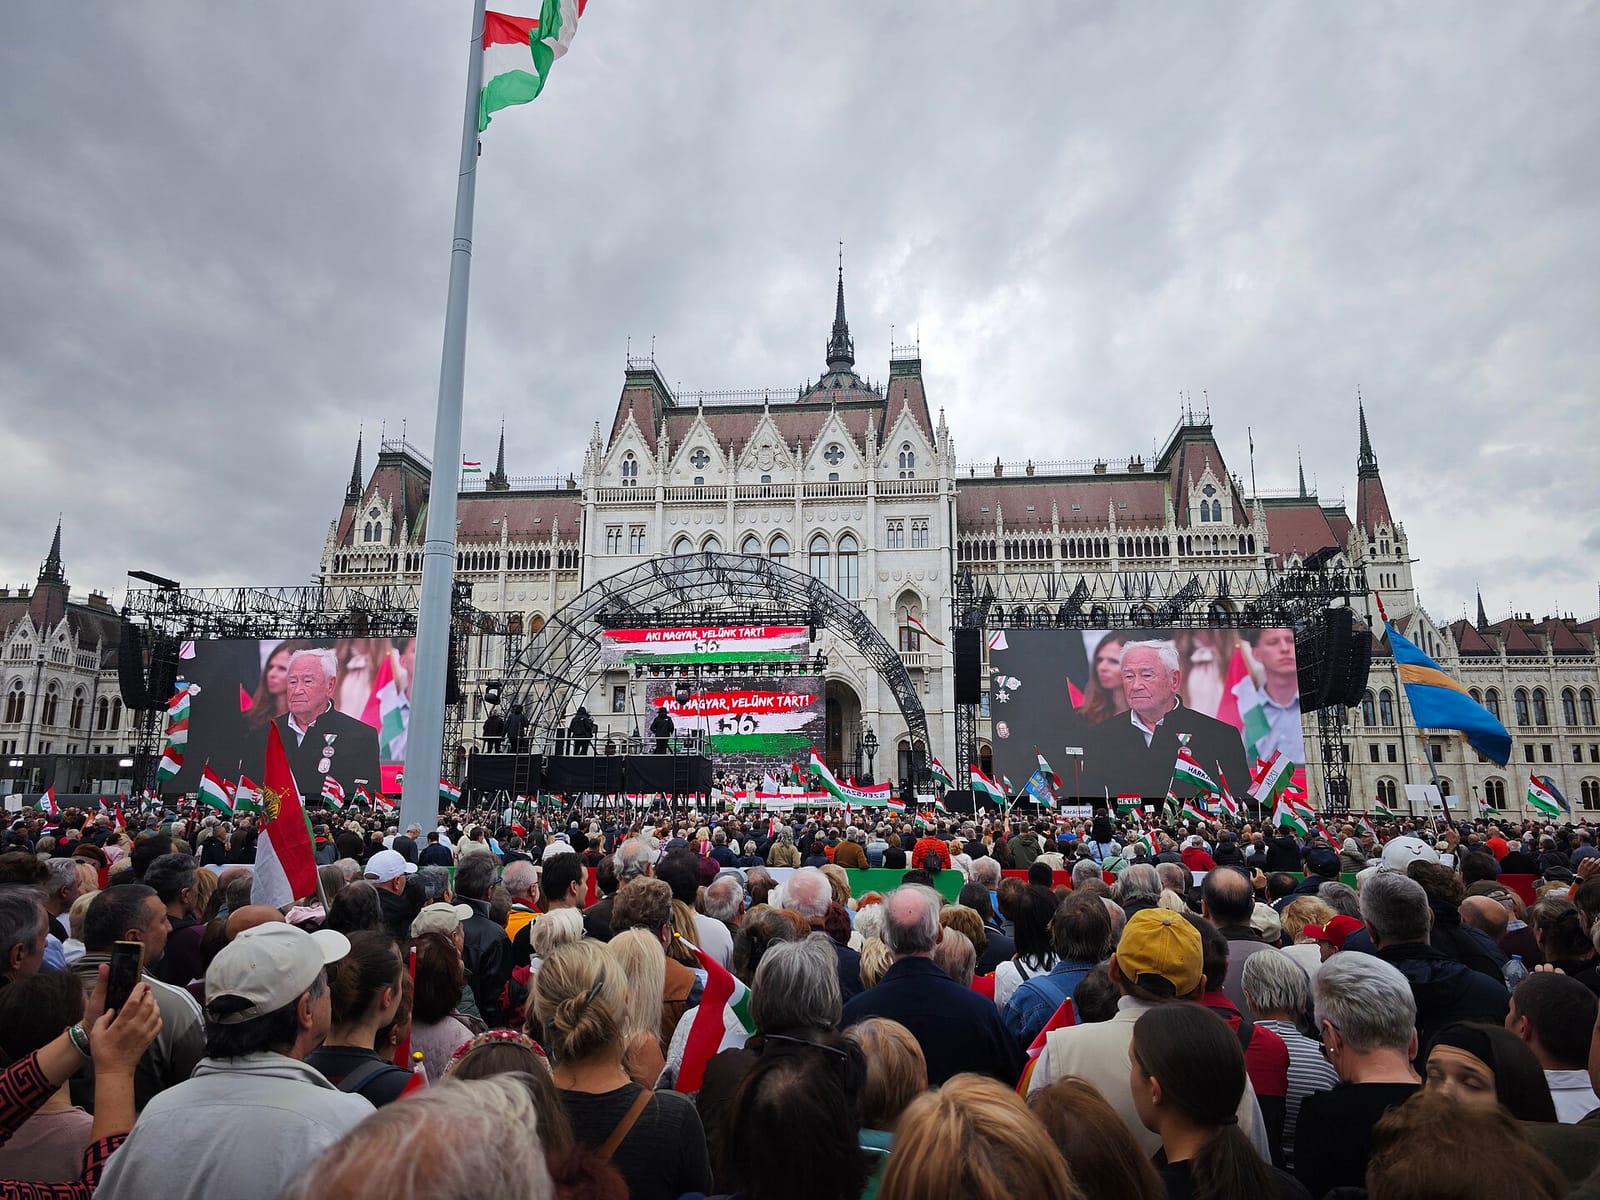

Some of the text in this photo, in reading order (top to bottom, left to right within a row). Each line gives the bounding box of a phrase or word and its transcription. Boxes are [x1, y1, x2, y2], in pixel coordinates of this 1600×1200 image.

[645, 627, 765, 641] AKI MAGYAR, VELÜNK TART!
[696, 641, 718, 653] 56
[662, 694, 809, 712] AKI MAGYAR, VELÜNK TART!
[722, 713, 755, 735] 56
